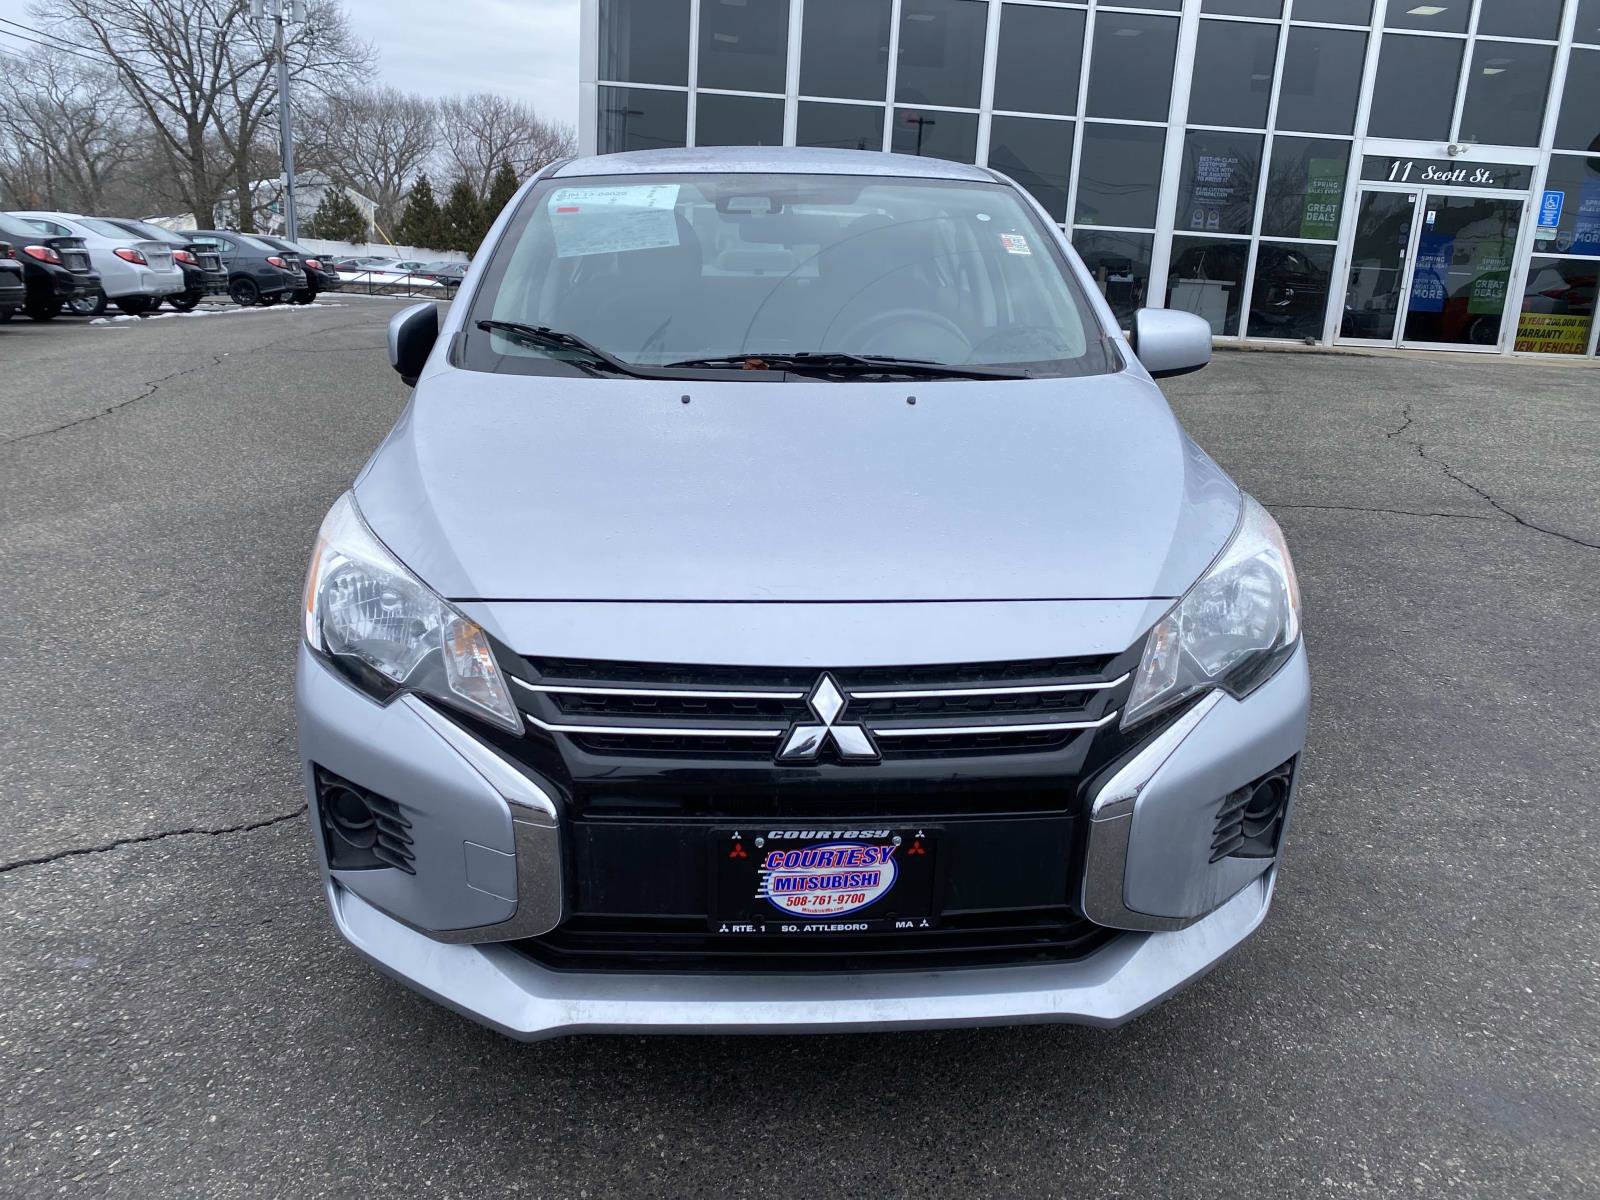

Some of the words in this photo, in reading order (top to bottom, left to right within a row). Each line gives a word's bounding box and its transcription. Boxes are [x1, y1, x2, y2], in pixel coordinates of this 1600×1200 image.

[1389, 161, 1413, 181] 11
[1422, 165, 1467, 182] Scott
[1470, 168, 1494, 184] St.
[1307, 203, 1337, 213] GREAT
[1306, 212, 1335, 222] DEALS
[1574, 232, 1600, 243] MOR
[1475, 279, 1505, 289] GREAT
[1412, 289, 1444, 299] MORE
[1473, 288, 1503, 297] DEALS
[766, 845, 896, 870] COURTESY
[774, 871, 881, 892] MITSUBISHI
[786, 893, 866, 907] 508-761-9700
[804, 923, 868, 932] ATTLEBORO
